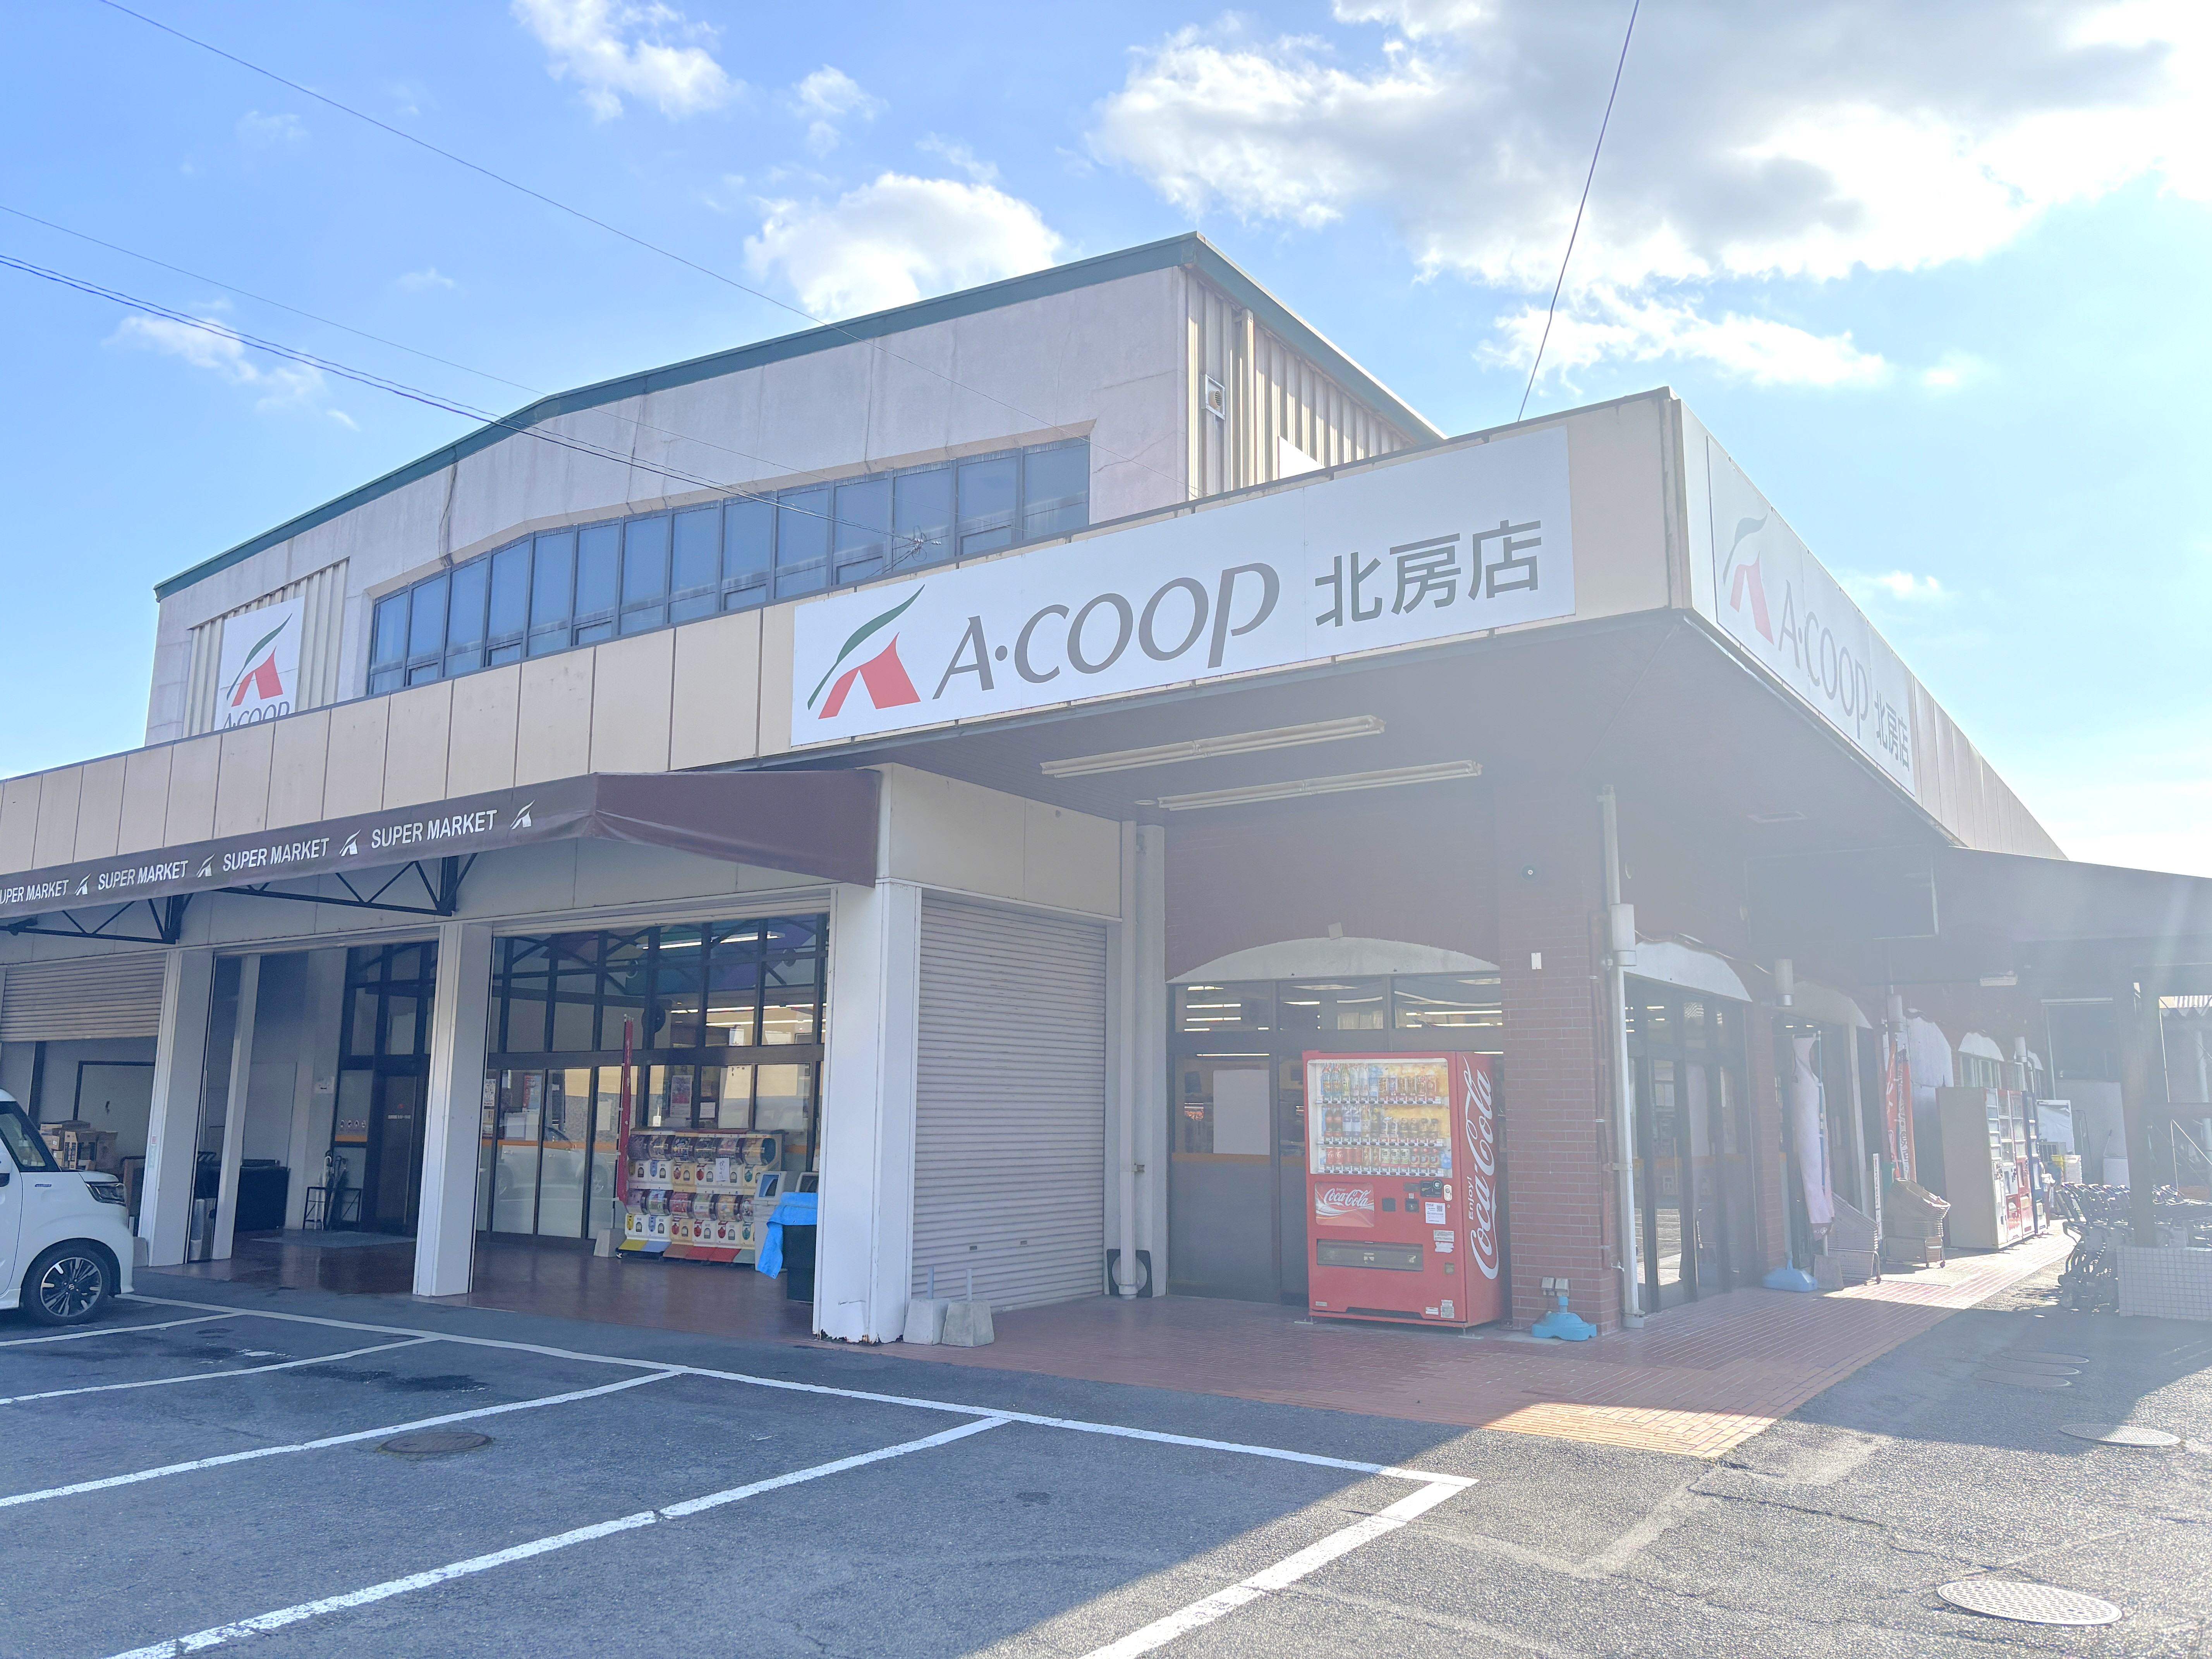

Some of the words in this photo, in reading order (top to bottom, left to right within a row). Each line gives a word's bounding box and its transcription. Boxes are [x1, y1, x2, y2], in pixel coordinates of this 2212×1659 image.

[1315, 520, 1541, 627] 北房店
[1874, 690, 1910, 772] 北房店
[371, 822, 423, 848] SUPER
[427, 810, 497, 840] MARKET
[223, 848, 267, 871] SUPER
[271, 838, 330, 864] MARKET
[0, 886, 24, 904] UPER
[26, 879, 69, 901] MARKET
[98, 869, 135, 890] SUPER
[137, 860, 188, 884] MARKET
[1463, 1055, 1499, 1279] Coca-Cola
[1323, 1188, 1372, 1207] Coca-Cola
